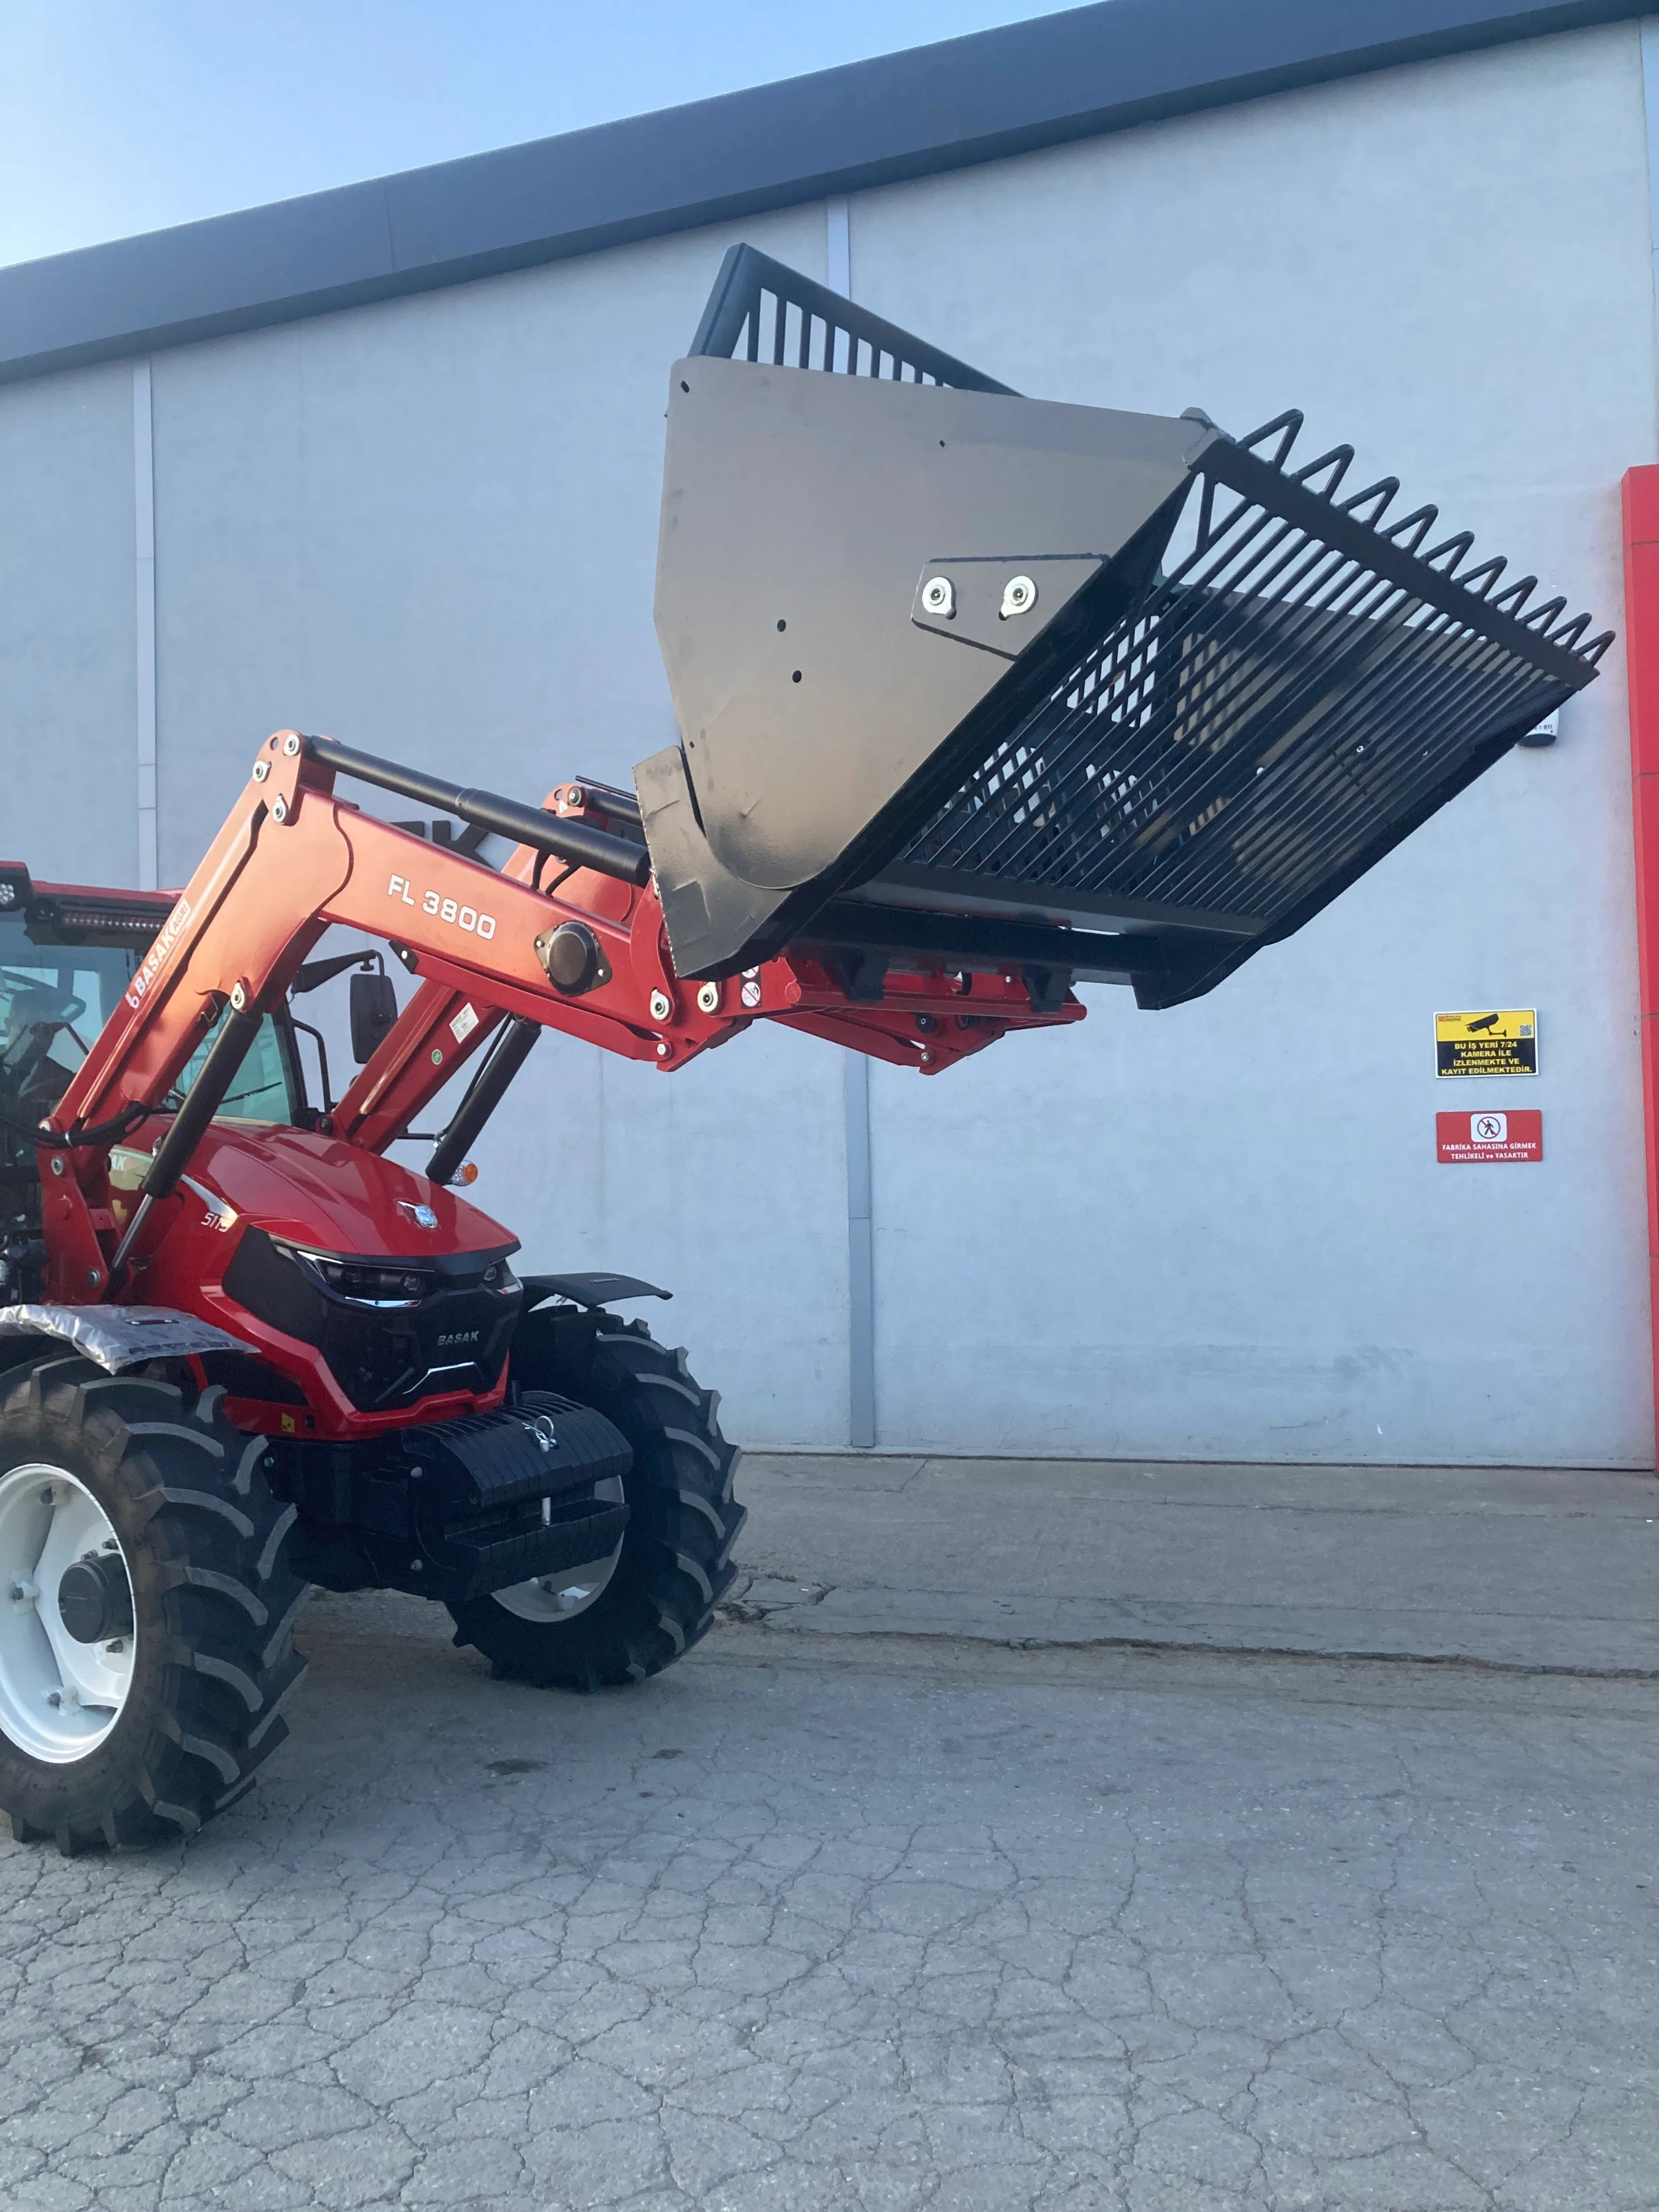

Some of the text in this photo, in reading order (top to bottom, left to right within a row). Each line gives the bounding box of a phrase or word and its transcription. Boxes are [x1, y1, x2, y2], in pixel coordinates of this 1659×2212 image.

[387, 873, 496, 940] FL 3800
[134, 924, 175, 996] BASAK
[173, 903, 188, 932] AGRI
[1468, 1042, 1477, 1050] İŞ
[1479, 1040, 1498, 1049] YERİ
[1453, 1058, 1507, 1067] İZLENMEKTE
[1442, 1143, 1471, 1151] FABRİKA
[437, 1331, 480, 1347] BASAK
